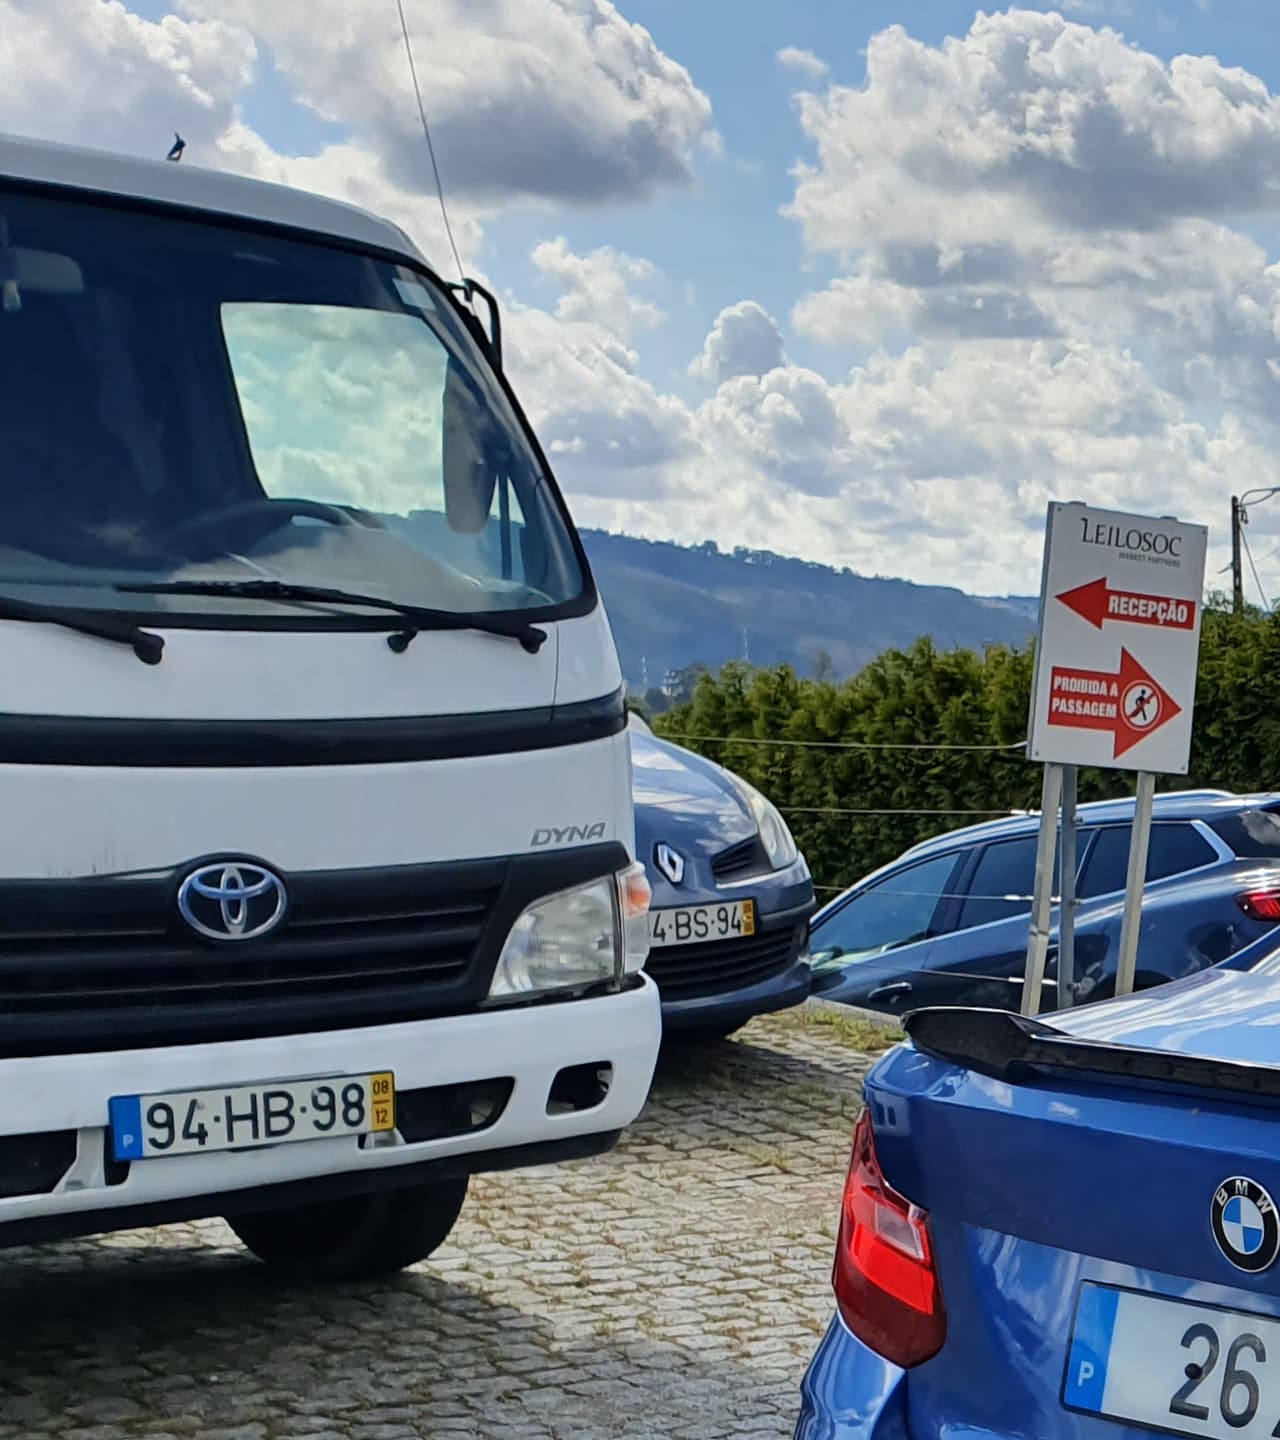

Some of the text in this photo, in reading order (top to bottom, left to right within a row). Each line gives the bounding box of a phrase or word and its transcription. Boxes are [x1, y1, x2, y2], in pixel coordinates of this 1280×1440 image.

[1080, 516, 1182, 557] LEILOSOC
[1109, 595, 1188, 624] RECEPÇÃO
[1053, 675, 1107, 696] PROIBIDA
[1051, 698, 1117, 718] PASSAGEM
[530, 822, 606, 846] DYNA
[372, 1079, 390, 1096] 08
[375, 1107, 389, 1124] 12
[122, 1134, 134, 1148] P
[1215, 1179, 1273, 1214] BMW
[1077, 1360, 1095, 1388] P
